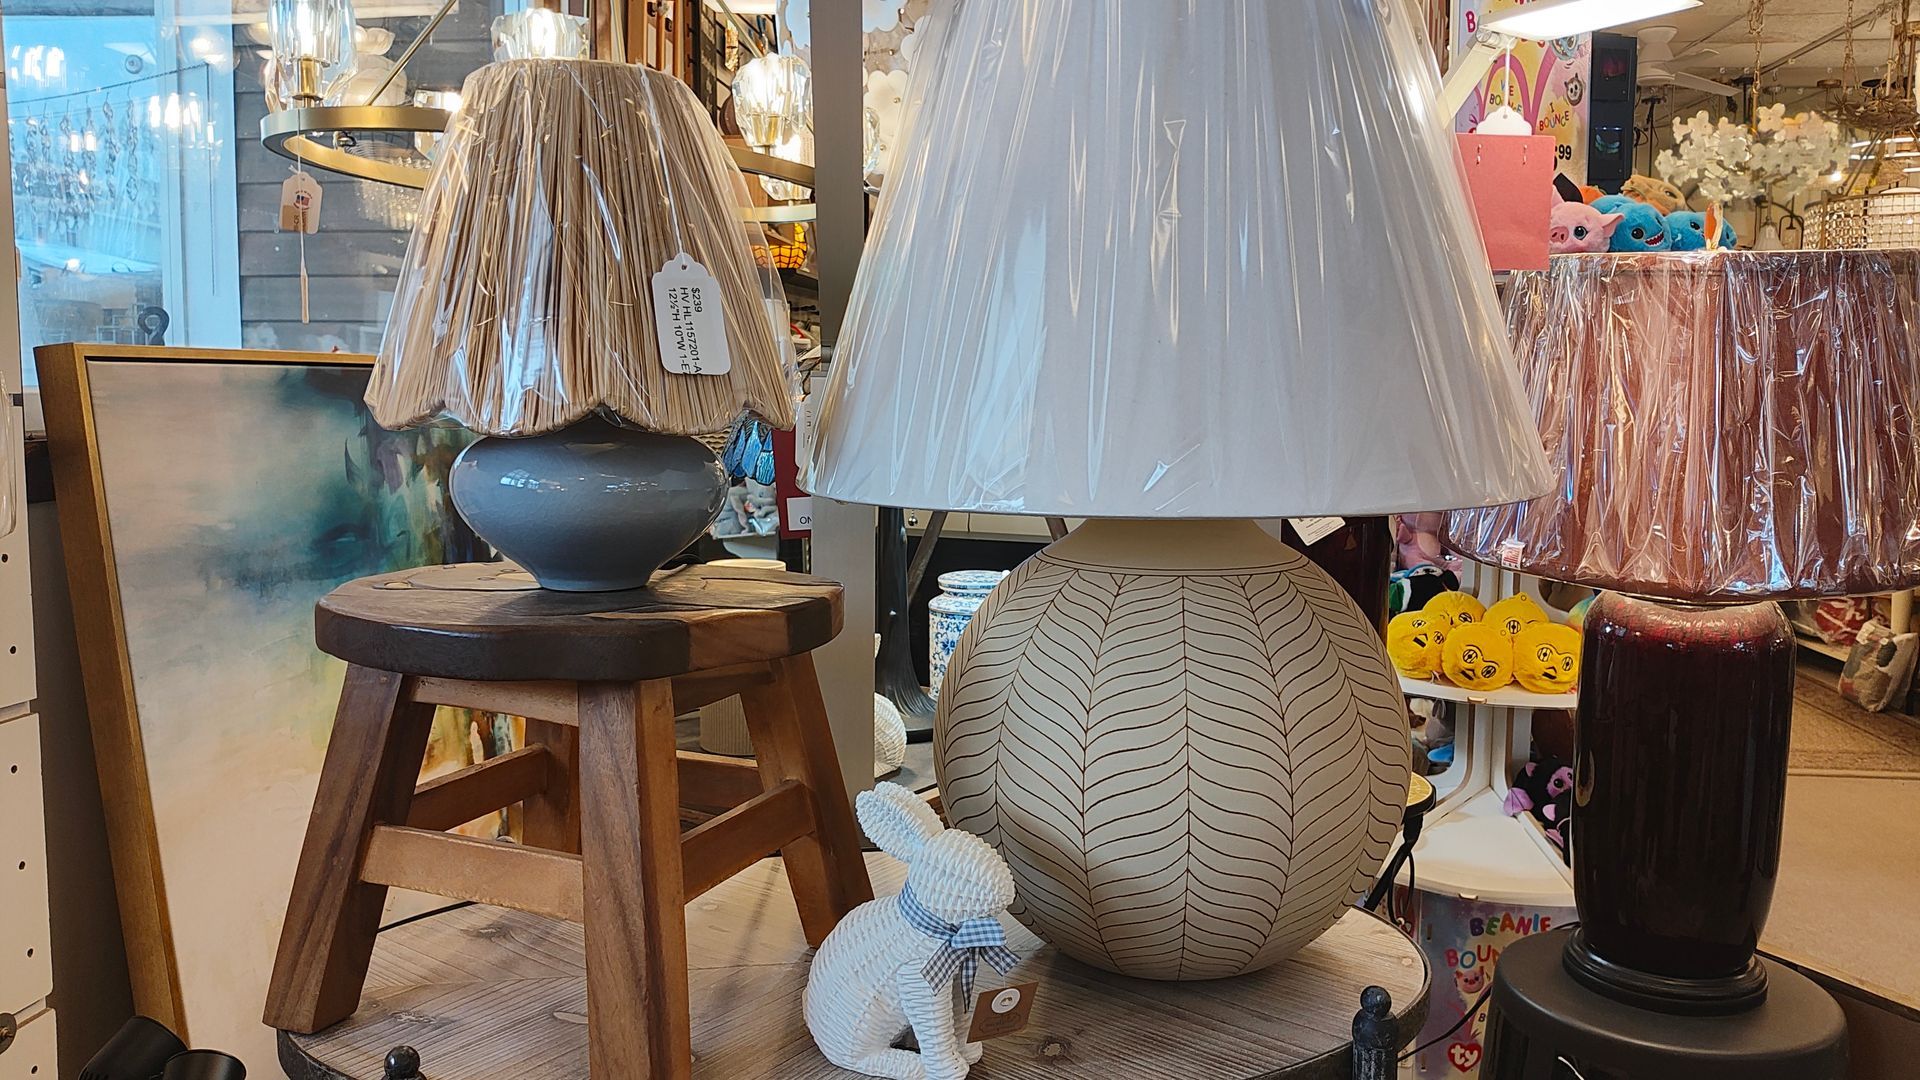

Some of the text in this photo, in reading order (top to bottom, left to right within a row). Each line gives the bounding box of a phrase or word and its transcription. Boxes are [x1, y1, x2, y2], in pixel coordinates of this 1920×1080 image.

[1539, 110, 1570, 131] BOUNCE
[680, 287, 690, 303] HV
[691, 287, 703, 313] $239
[674, 325, 687, 351] 10"W
[1469, 912, 1552, 937] BEANIE
[1450, 1043, 1479, 1068] ty
